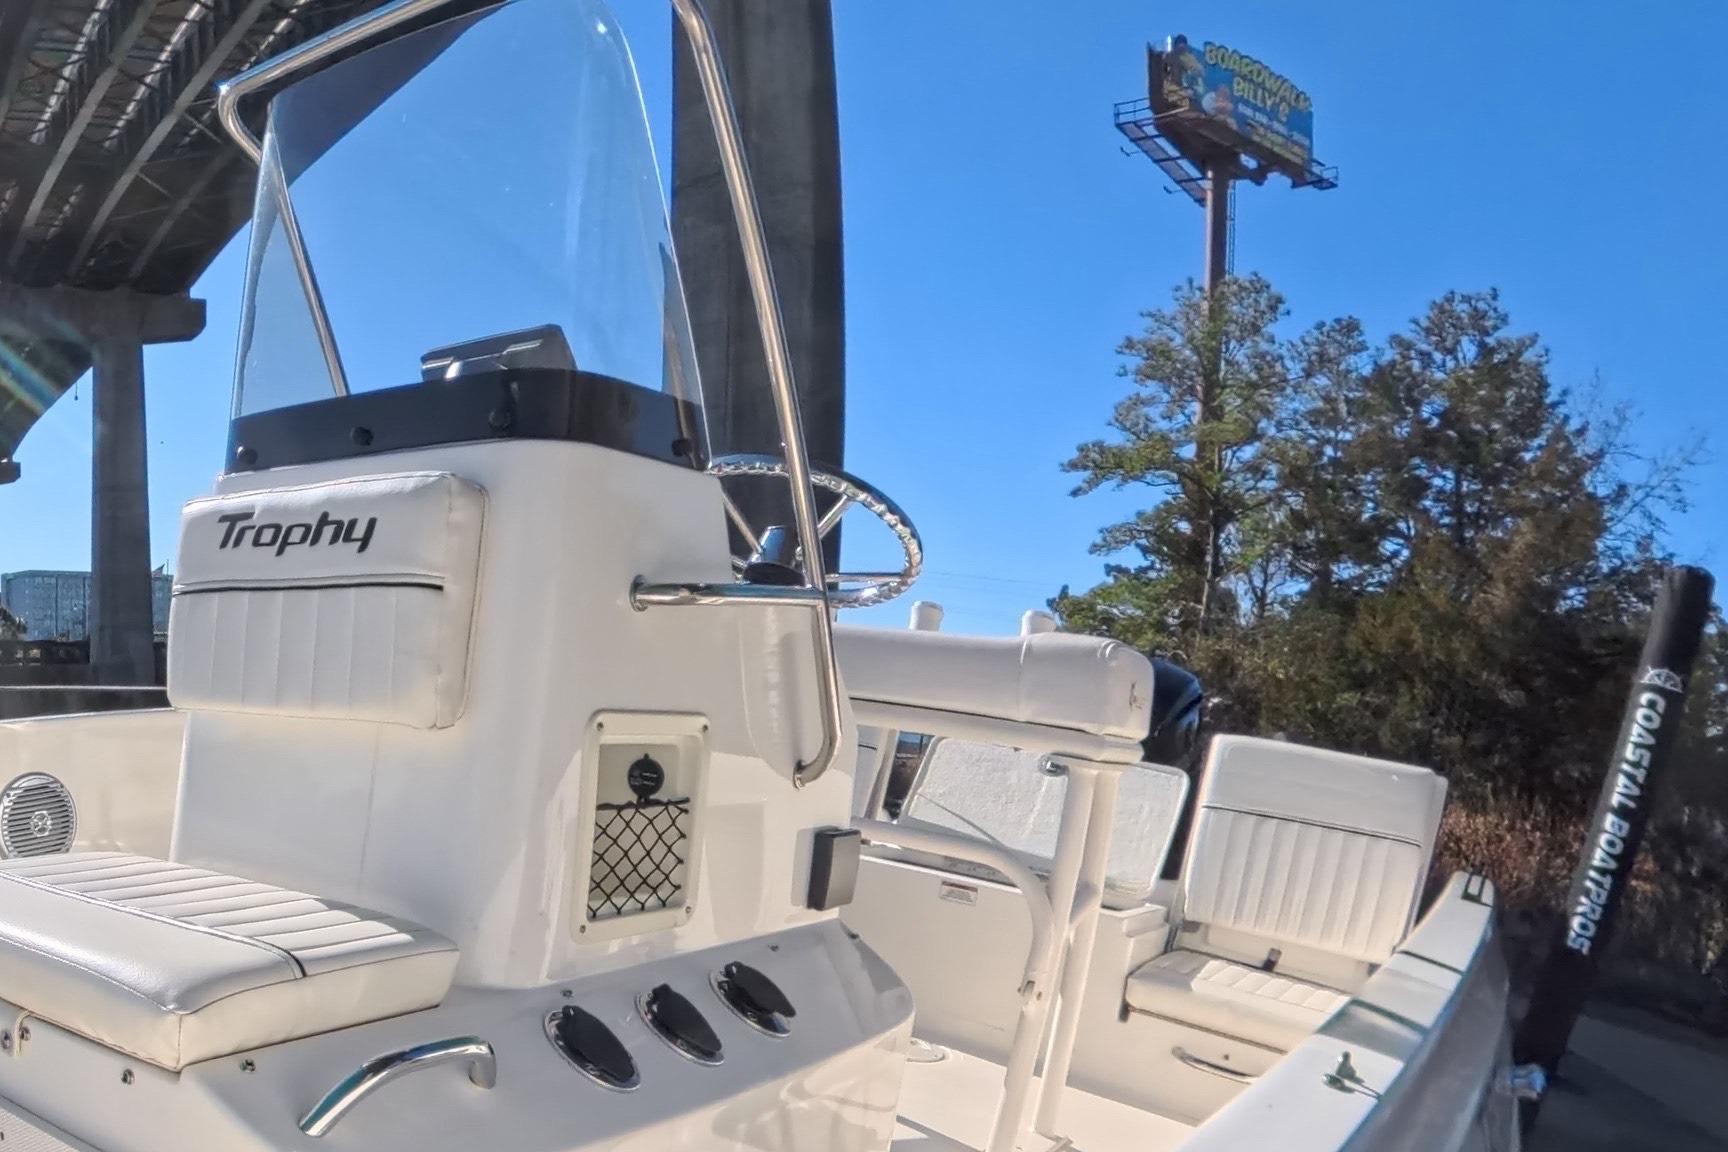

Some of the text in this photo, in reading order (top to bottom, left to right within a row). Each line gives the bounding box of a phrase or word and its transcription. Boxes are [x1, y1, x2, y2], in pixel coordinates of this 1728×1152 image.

[217, 511, 378, 557] Trophy
[1566, 691, 1666, 956] COASTAL BOATPROS
